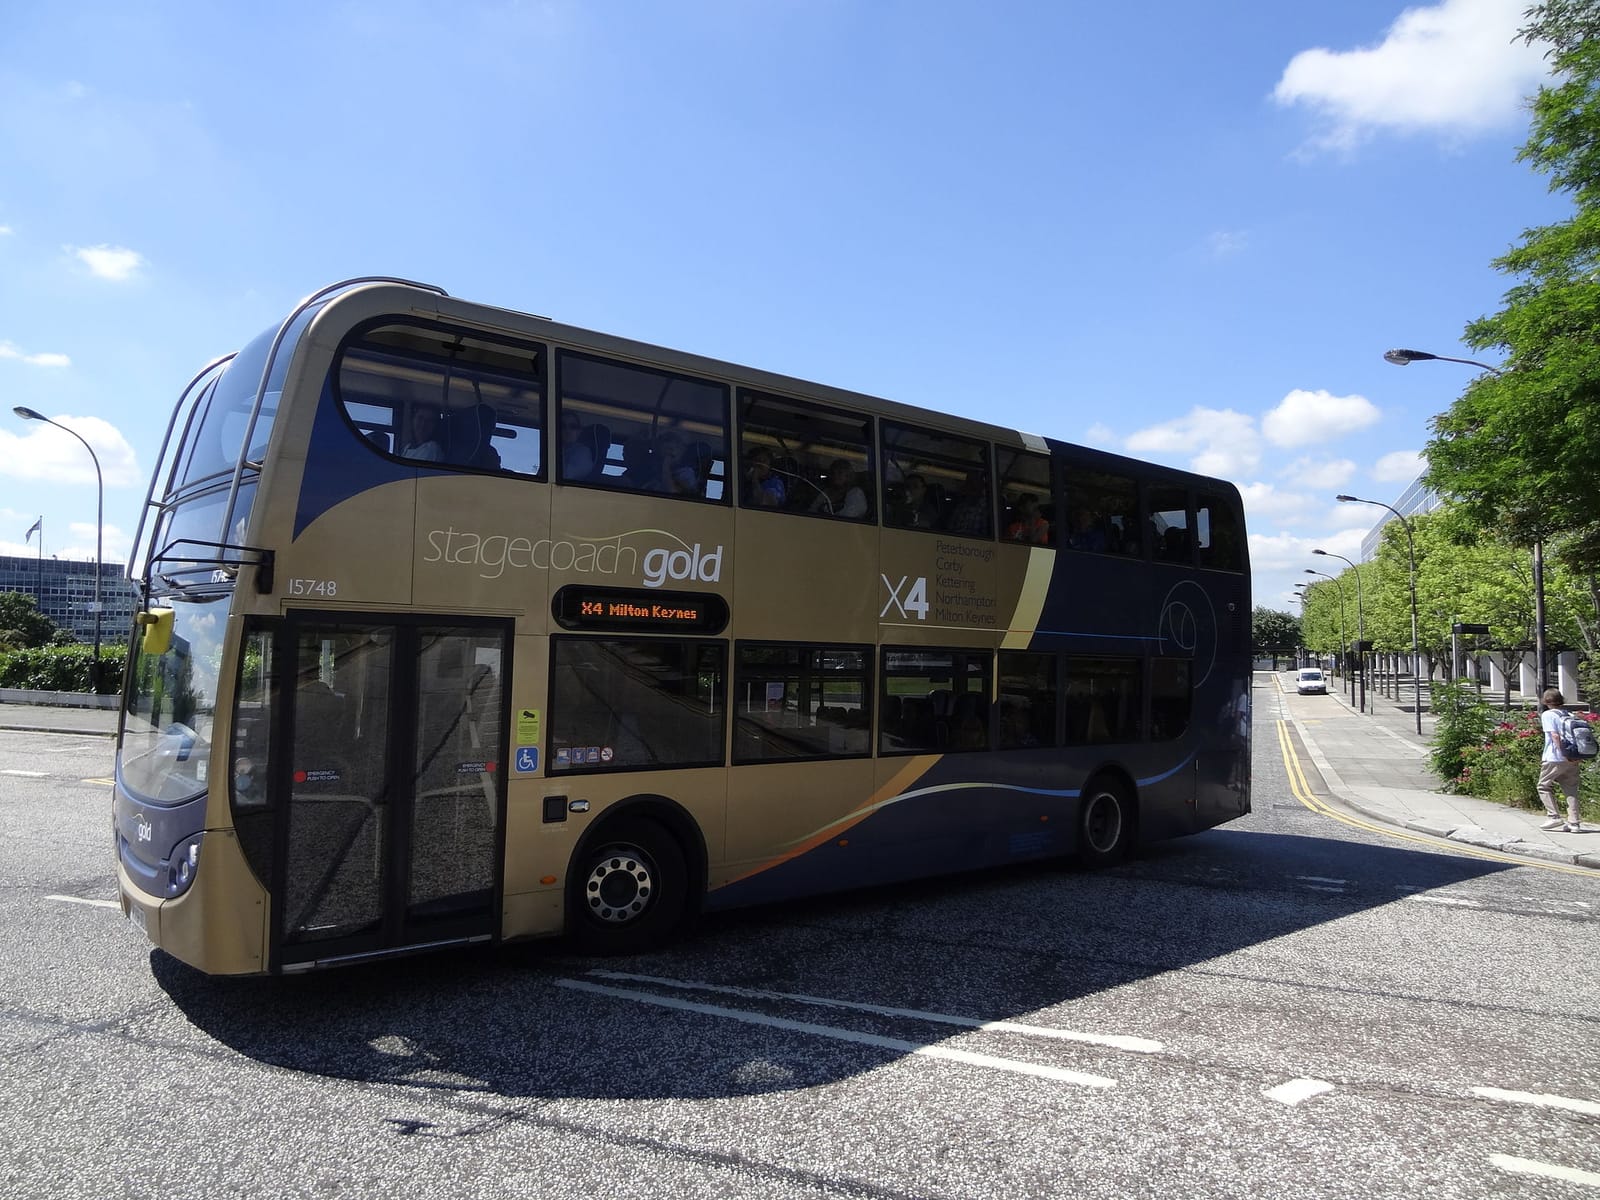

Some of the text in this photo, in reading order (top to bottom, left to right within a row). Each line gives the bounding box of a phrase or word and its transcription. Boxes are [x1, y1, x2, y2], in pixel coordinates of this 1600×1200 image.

[423, 525, 723, 587] stagecoach gold
[936, 557, 963, 574] Corby
[288, 578, 337, 596] 15748
[936, 574, 977, 593] Kettering
[879, 573, 930, 620] X4
[936, 591, 996, 609] Northampton
[581, 601, 697, 620] X4 Milton Keynes
[935, 607, 996, 624] Milton Keynes
[138, 823, 152, 842] gold
